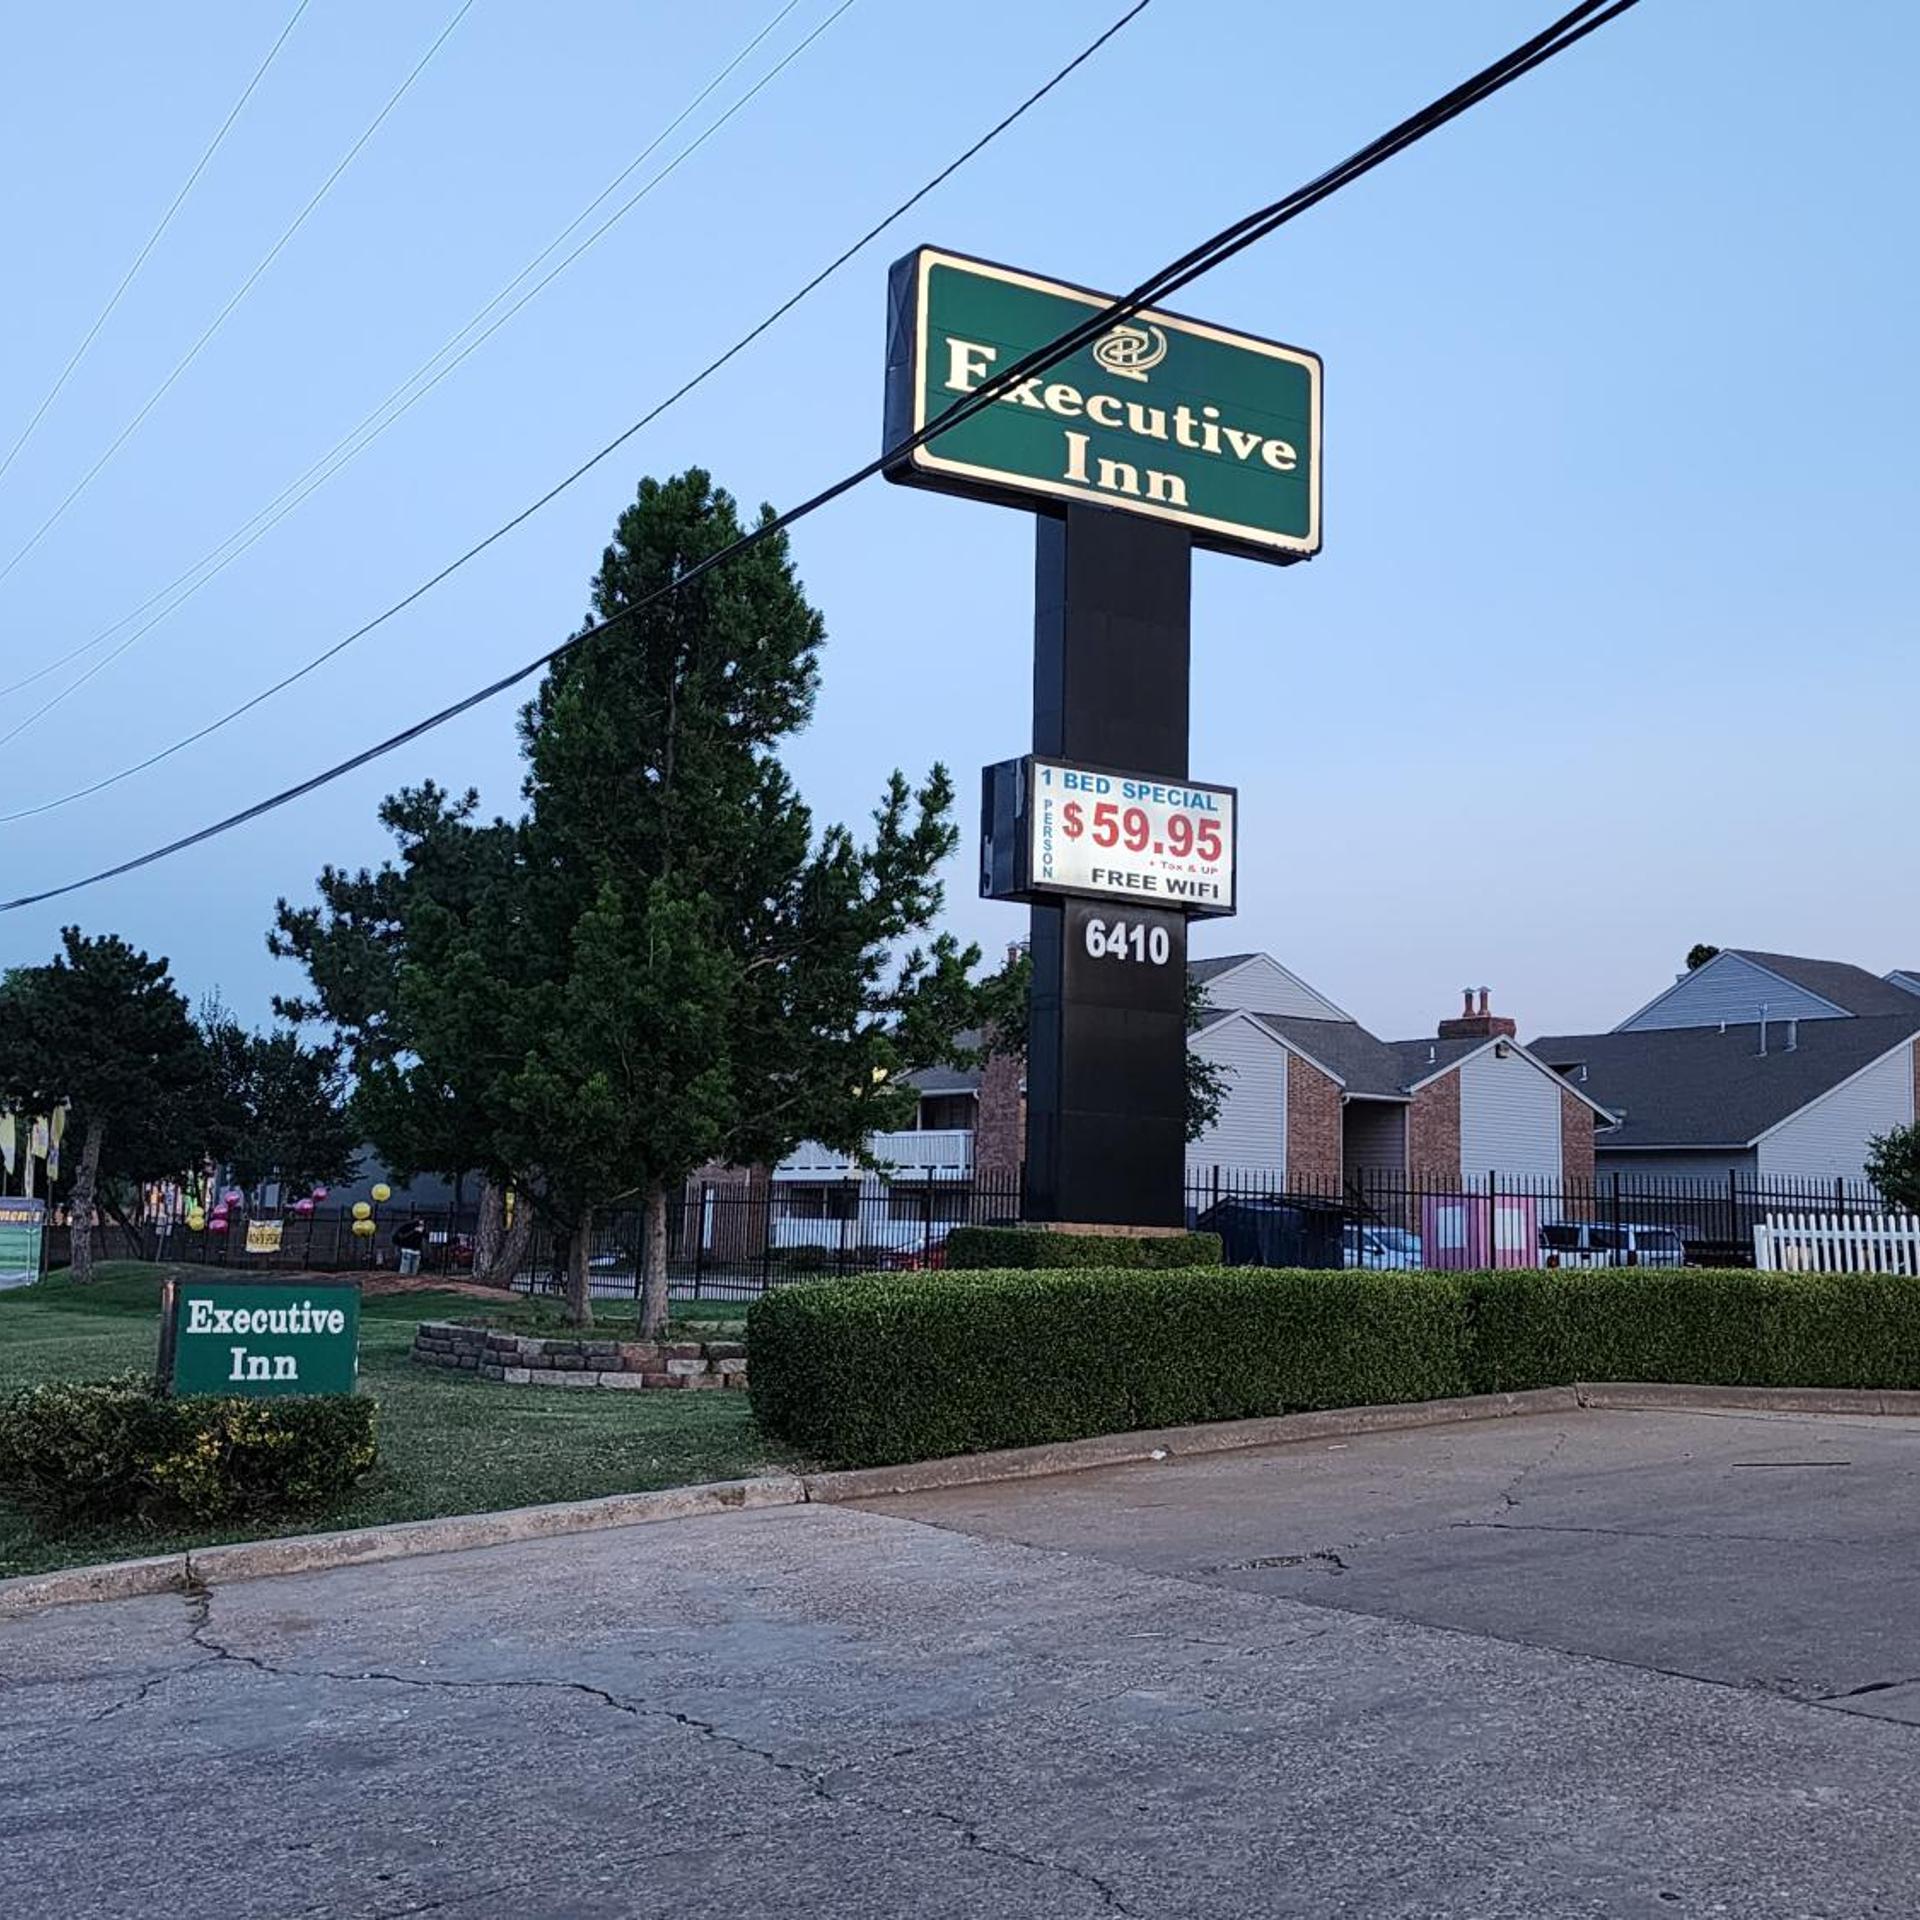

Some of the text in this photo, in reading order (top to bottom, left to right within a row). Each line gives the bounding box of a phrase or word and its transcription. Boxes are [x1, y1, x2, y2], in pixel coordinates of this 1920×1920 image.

[944, 337, 1298, 470] Executive
[1063, 431, 1188, 506] Inn
[1041, 769, 1218, 811] 1 BED SPECIAL
[1043, 799, 1053, 878] PERSON
[1092, 868, 1218, 898] FREE WIFI
[1201, 866, 1219, 875] UP
[1086, 919, 1169, 965] 6410
[186, 1300, 345, 1334] Executive
[229, 1347, 298, 1381] Inn
